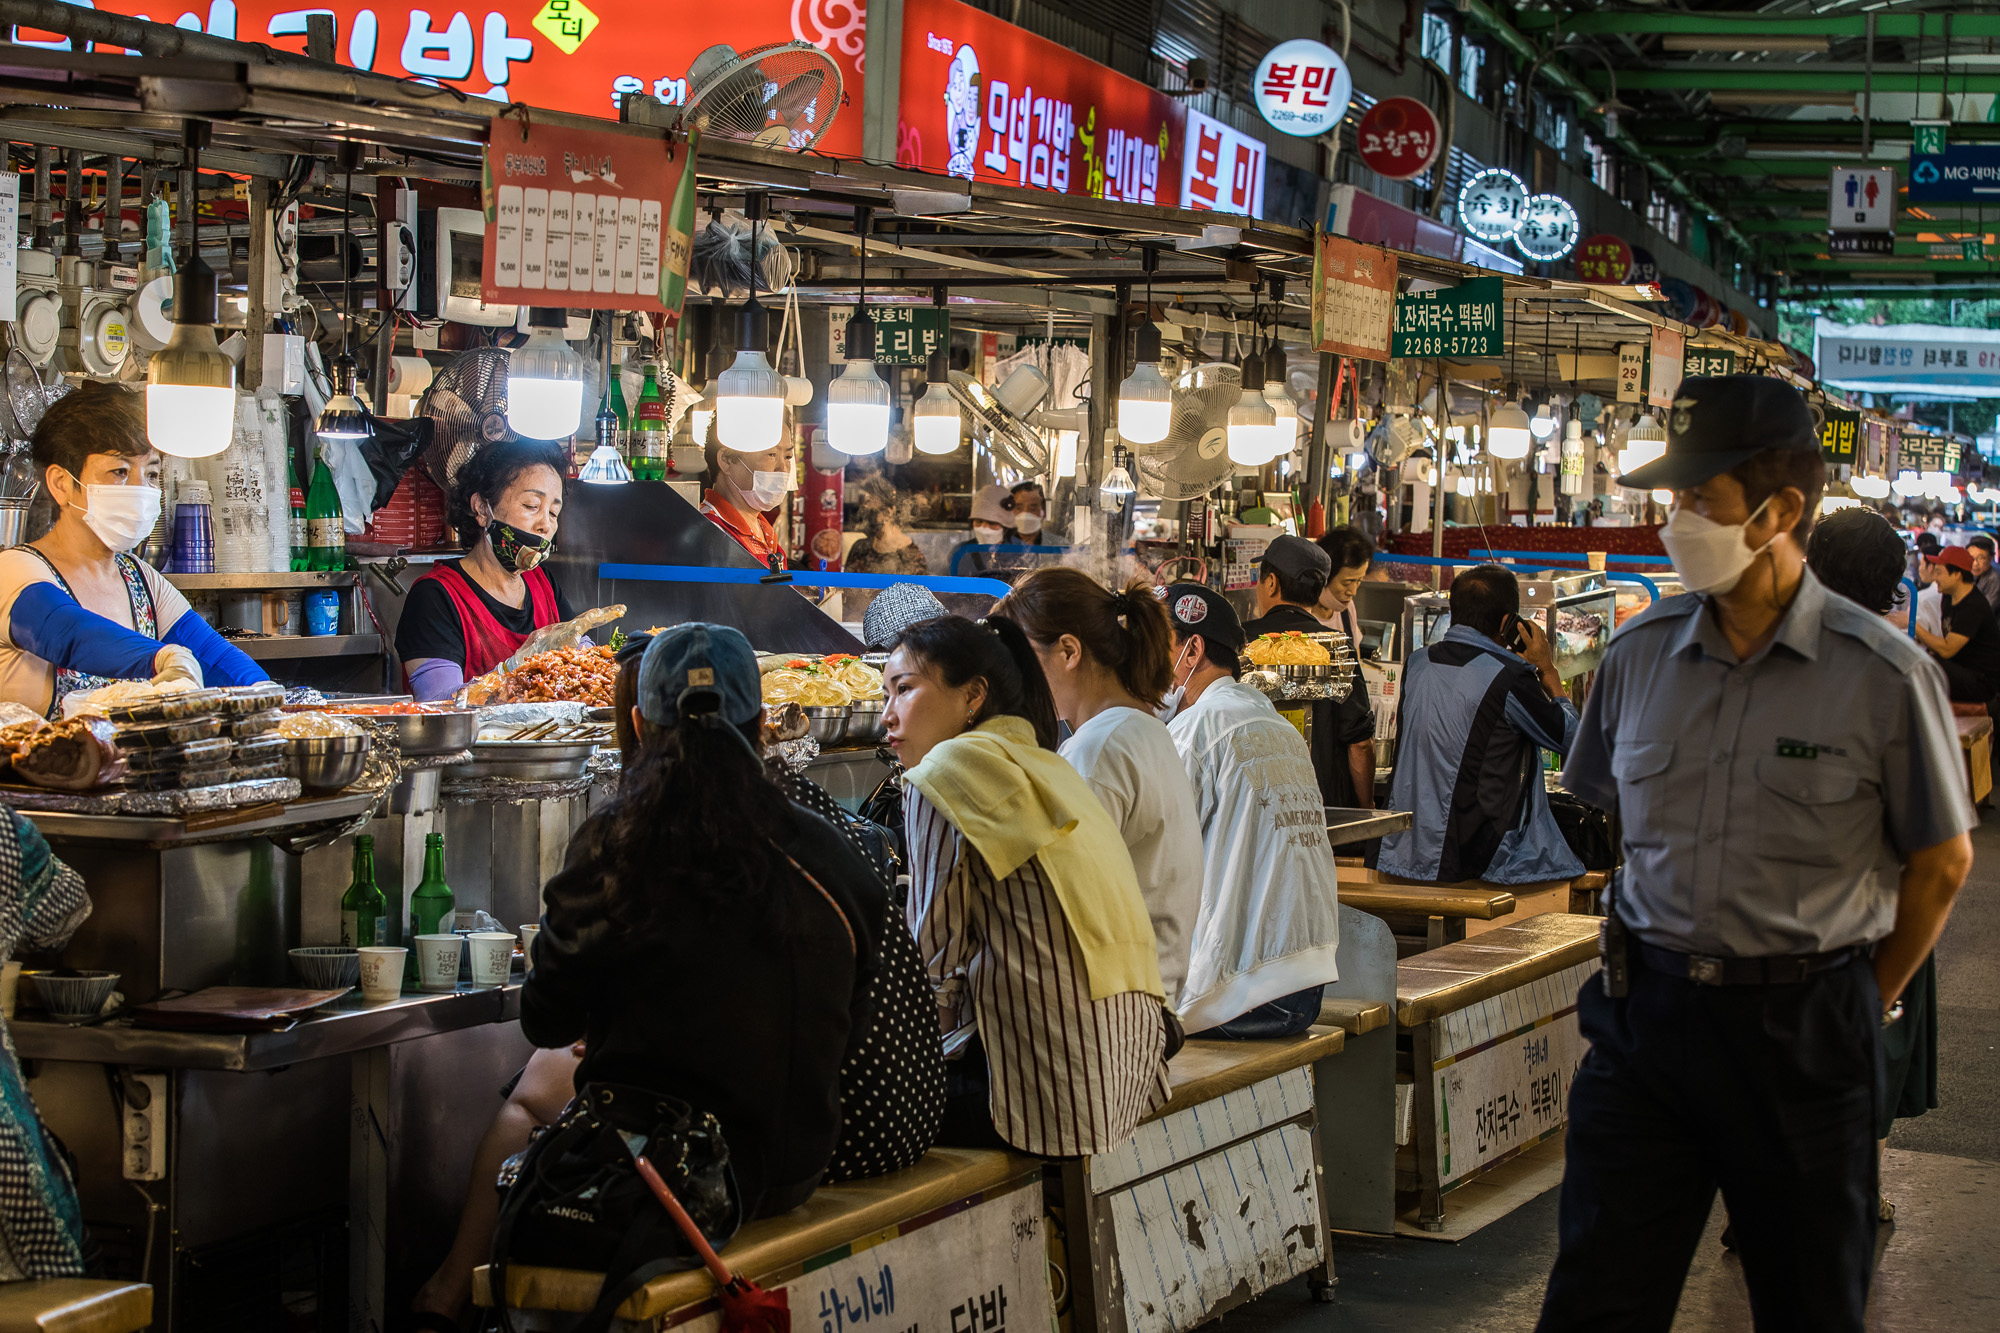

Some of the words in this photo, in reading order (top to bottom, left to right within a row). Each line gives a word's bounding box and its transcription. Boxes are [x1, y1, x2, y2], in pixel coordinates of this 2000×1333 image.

[546, 0, 583, 43] 모녀
[1263, 63, 1337, 107] 복민
[1271, 109, 1324, 123] 2269-4561
[983, 79, 1075, 194] 모녀김밥
[1363, 130, 1430, 159] 고향집
[1405, 336, 1487, 355] 2268-5723
[1621, 354, 1641, 364] 동부A
[1622, 367, 1637, 379] 29
[1624, 382, 1635, 393] 호
[1475, 1089, 1521, 1154] 잔치국수
[1530, 1067, 1563, 1124] 떡볶이
[548, 1206, 595, 1223] ANGOL
[818, 1264, 894, 1333] 하니네
